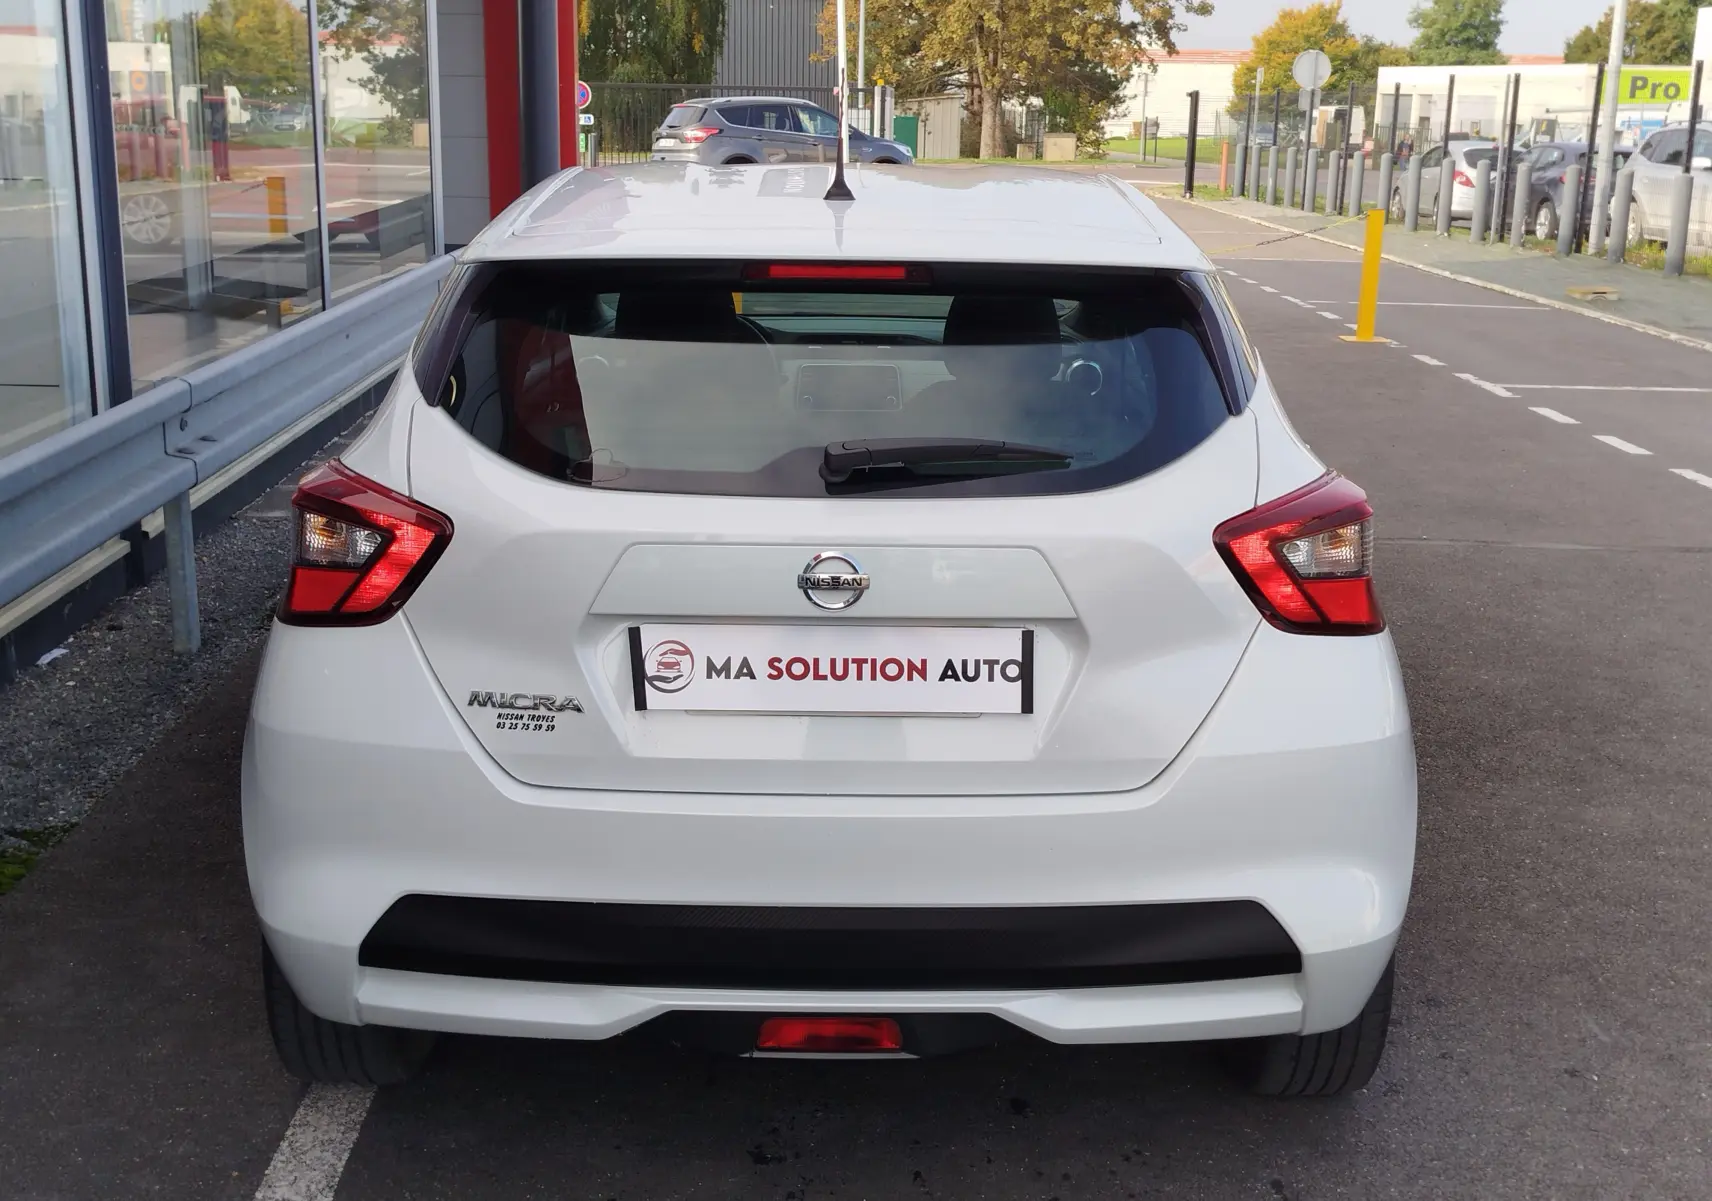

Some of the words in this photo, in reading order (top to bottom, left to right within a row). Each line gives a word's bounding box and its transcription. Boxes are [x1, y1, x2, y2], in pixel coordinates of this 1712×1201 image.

[1629, 75, 1681, 100] Pro
[805, 577, 863, 587] NISSAN
[706, 655, 757, 680] MA
[767, 656, 928, 682] SOLUTION
[938, 658, 1023, 683] AUTO
[467, 689, 585, 713] MICRA
[496, 712, 524, 721] NISSAN
[527, 713, 555, 723] TROYES
[496, 721, 506, 730] 03
[508, 722, 518, 730] 25
[520, 722, 531, 731] 75
[532, 723, 543, 732] 59
[545, 724, 556, 732] 59
